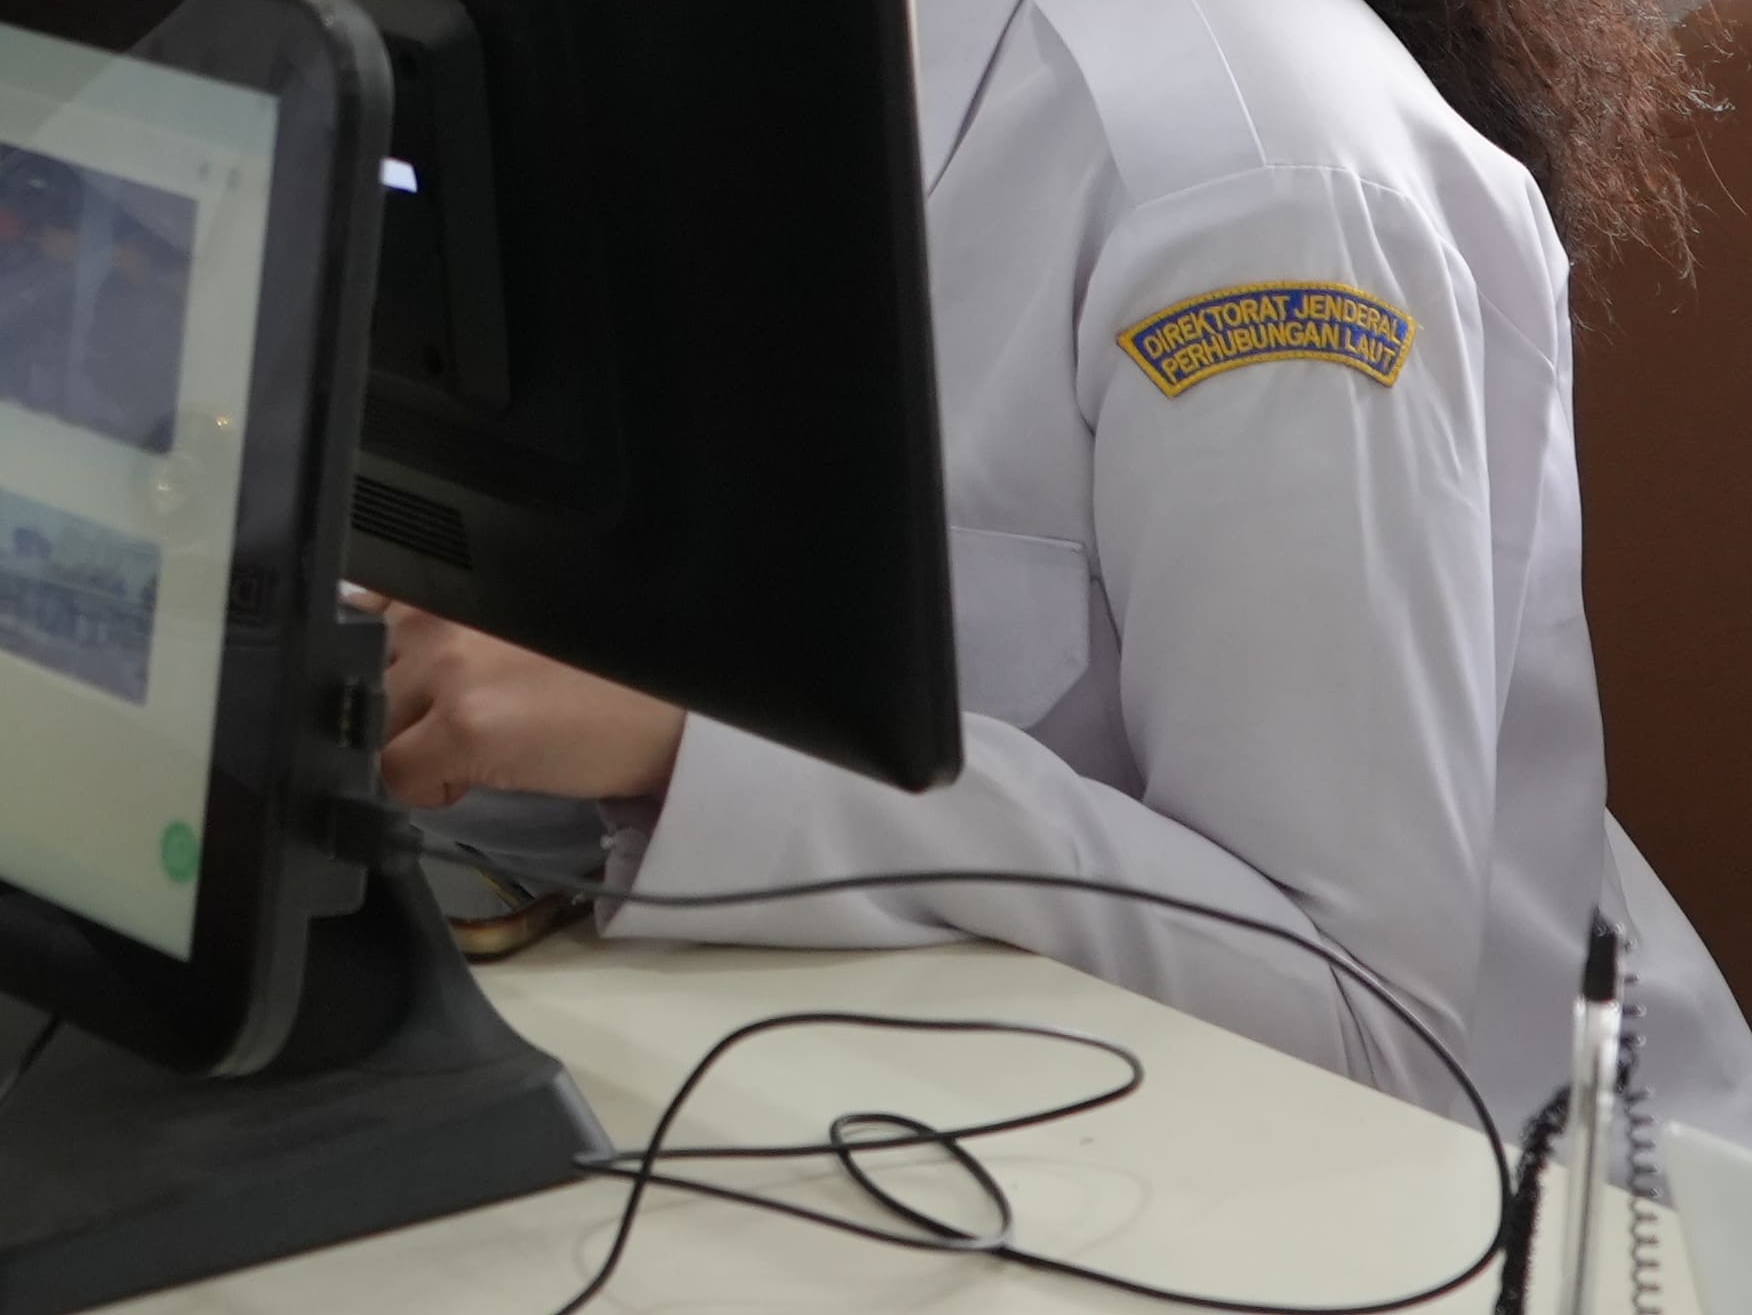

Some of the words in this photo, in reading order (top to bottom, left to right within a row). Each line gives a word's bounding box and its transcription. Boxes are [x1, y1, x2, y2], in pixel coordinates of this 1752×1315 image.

[1144, 295, 1290, 360] DIREKTORAT
[1295, 294, 1402, 346] JENDERAL
[1162, 322, 1339, 383] PERHUBUNGAN
[1344, 325, 1395, 371] LAUT
